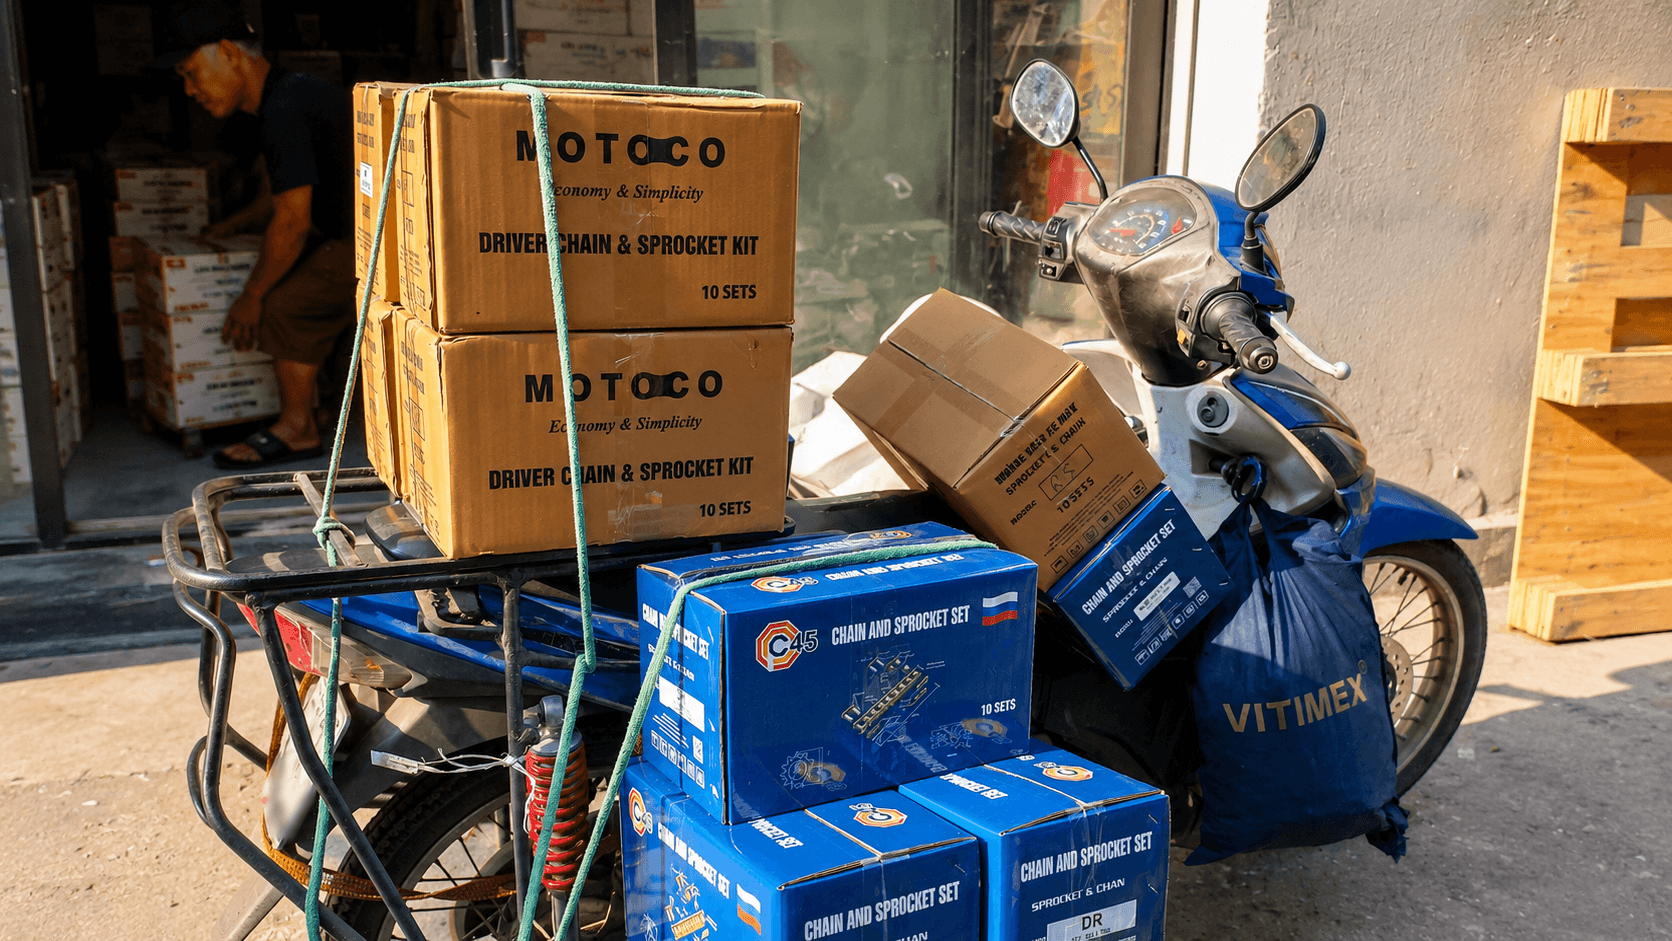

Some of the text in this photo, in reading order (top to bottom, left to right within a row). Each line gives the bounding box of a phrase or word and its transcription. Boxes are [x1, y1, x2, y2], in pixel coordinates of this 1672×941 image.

[516, 130, 726, 168] MOTOCO
[552, 183, 704, 203] conomy & Simplicity
[479, 232, 759, 256] DRIVER CHAIN & SPROCKET KIT
[702, 284, 758, 300] 10 SETS
[524, 370, 724, 403] MOTOCO
[548, 415, 702, 435] Ecnomy & Simplicity
[488, 468, 555, 490] DRIVER
[620, 463, 634, 482] &
[640, 458, 725, 481] SPROCKET
[728, 456, 754, 475] KIT
[699, 500, 752, 518] 10 SETS
[1105, 571, 1125, 594] AND
[1122, 533, 1162, 576] SPROCKET
[1158, 518, 1176, 539] SET
[831, 604, 971, 646] CHAIN AND SPROCKET SET
[980, 698, 1016, 716] 10 SETS
[1222, 673, 1368, 733] VITIMEX
[1020, 831, 1152, 883] CHAIN AND SPROCKET SET
[804, 880, 960, 941] CHAIN AND SPROCKET SET
[1031, 878, 1126, 913] SPROCKET & CHAN
[1082, 912, 1103, 931] DR
